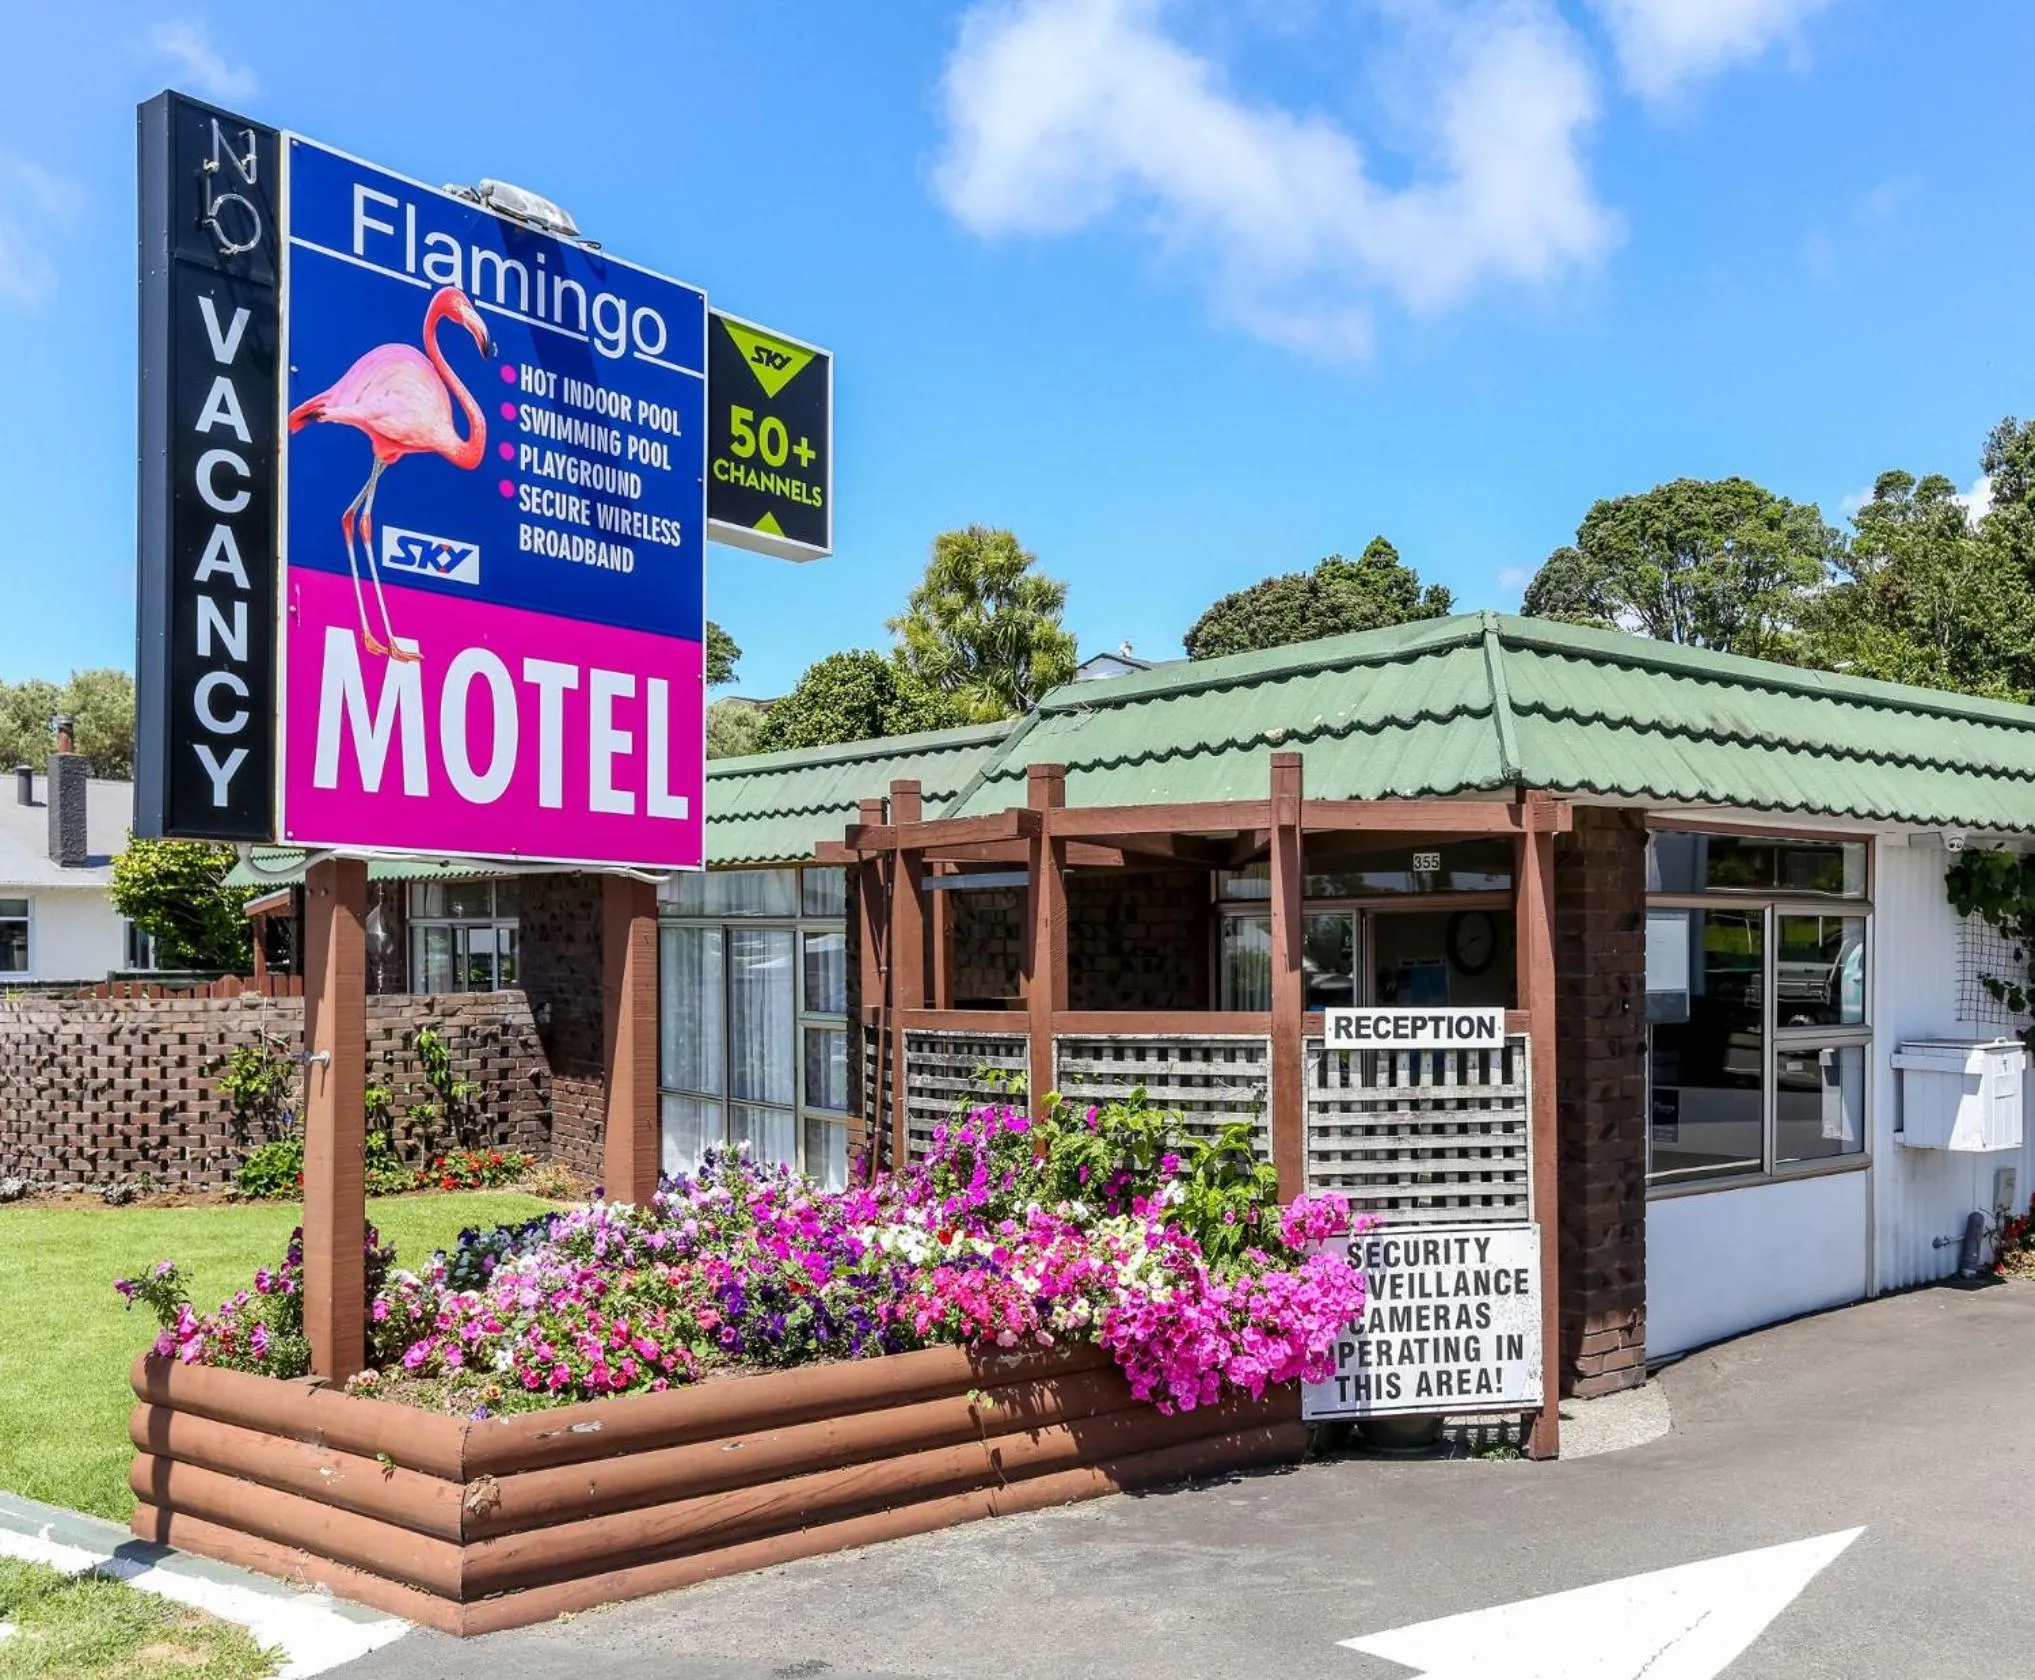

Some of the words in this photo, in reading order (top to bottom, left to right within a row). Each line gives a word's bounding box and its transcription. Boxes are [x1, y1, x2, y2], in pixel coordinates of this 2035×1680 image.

[202, 117, 262, 255] NO
[352, 182, 668, 360] Flamingo
[752, 344, 793, 371] SKY
[519, 363, 558, 399] HOT
[562, 376, 632, 422] INDOOR
[637, 399, 682, 437] POOL
[519, 403, 621, 457] SWIMMING
[627, 434, 672, 471] POOL
[730, 404, 816, 468] 50+
[519, 442, 642, 500] PLAYGROUND
[713, 457, 823, 508] CHANNELS
[518, 483, 591, 526] SECURE
[596, 501, 681, 547] WIRELESS
[193, 294, 252, 808] VACANCY
[389, 535, 474, 574] SKY
[519, 522, 635, 574] BROADBAND
[313, 625, 689, 820] MOTEL
[1414, 855, 1440, 870] 355
[1334, 1015, 1496, 1039] RECEPTION
[1347, 1236, 1491, 1269] SECURITY
[1368, 1268, 1530, 1301] VEILLANCE
[1495, 1334, 1524, 1361] IN
[1334, 1372, 1401, 1402] THIS
[1415, 1367, 1503, 1398] AREA!
